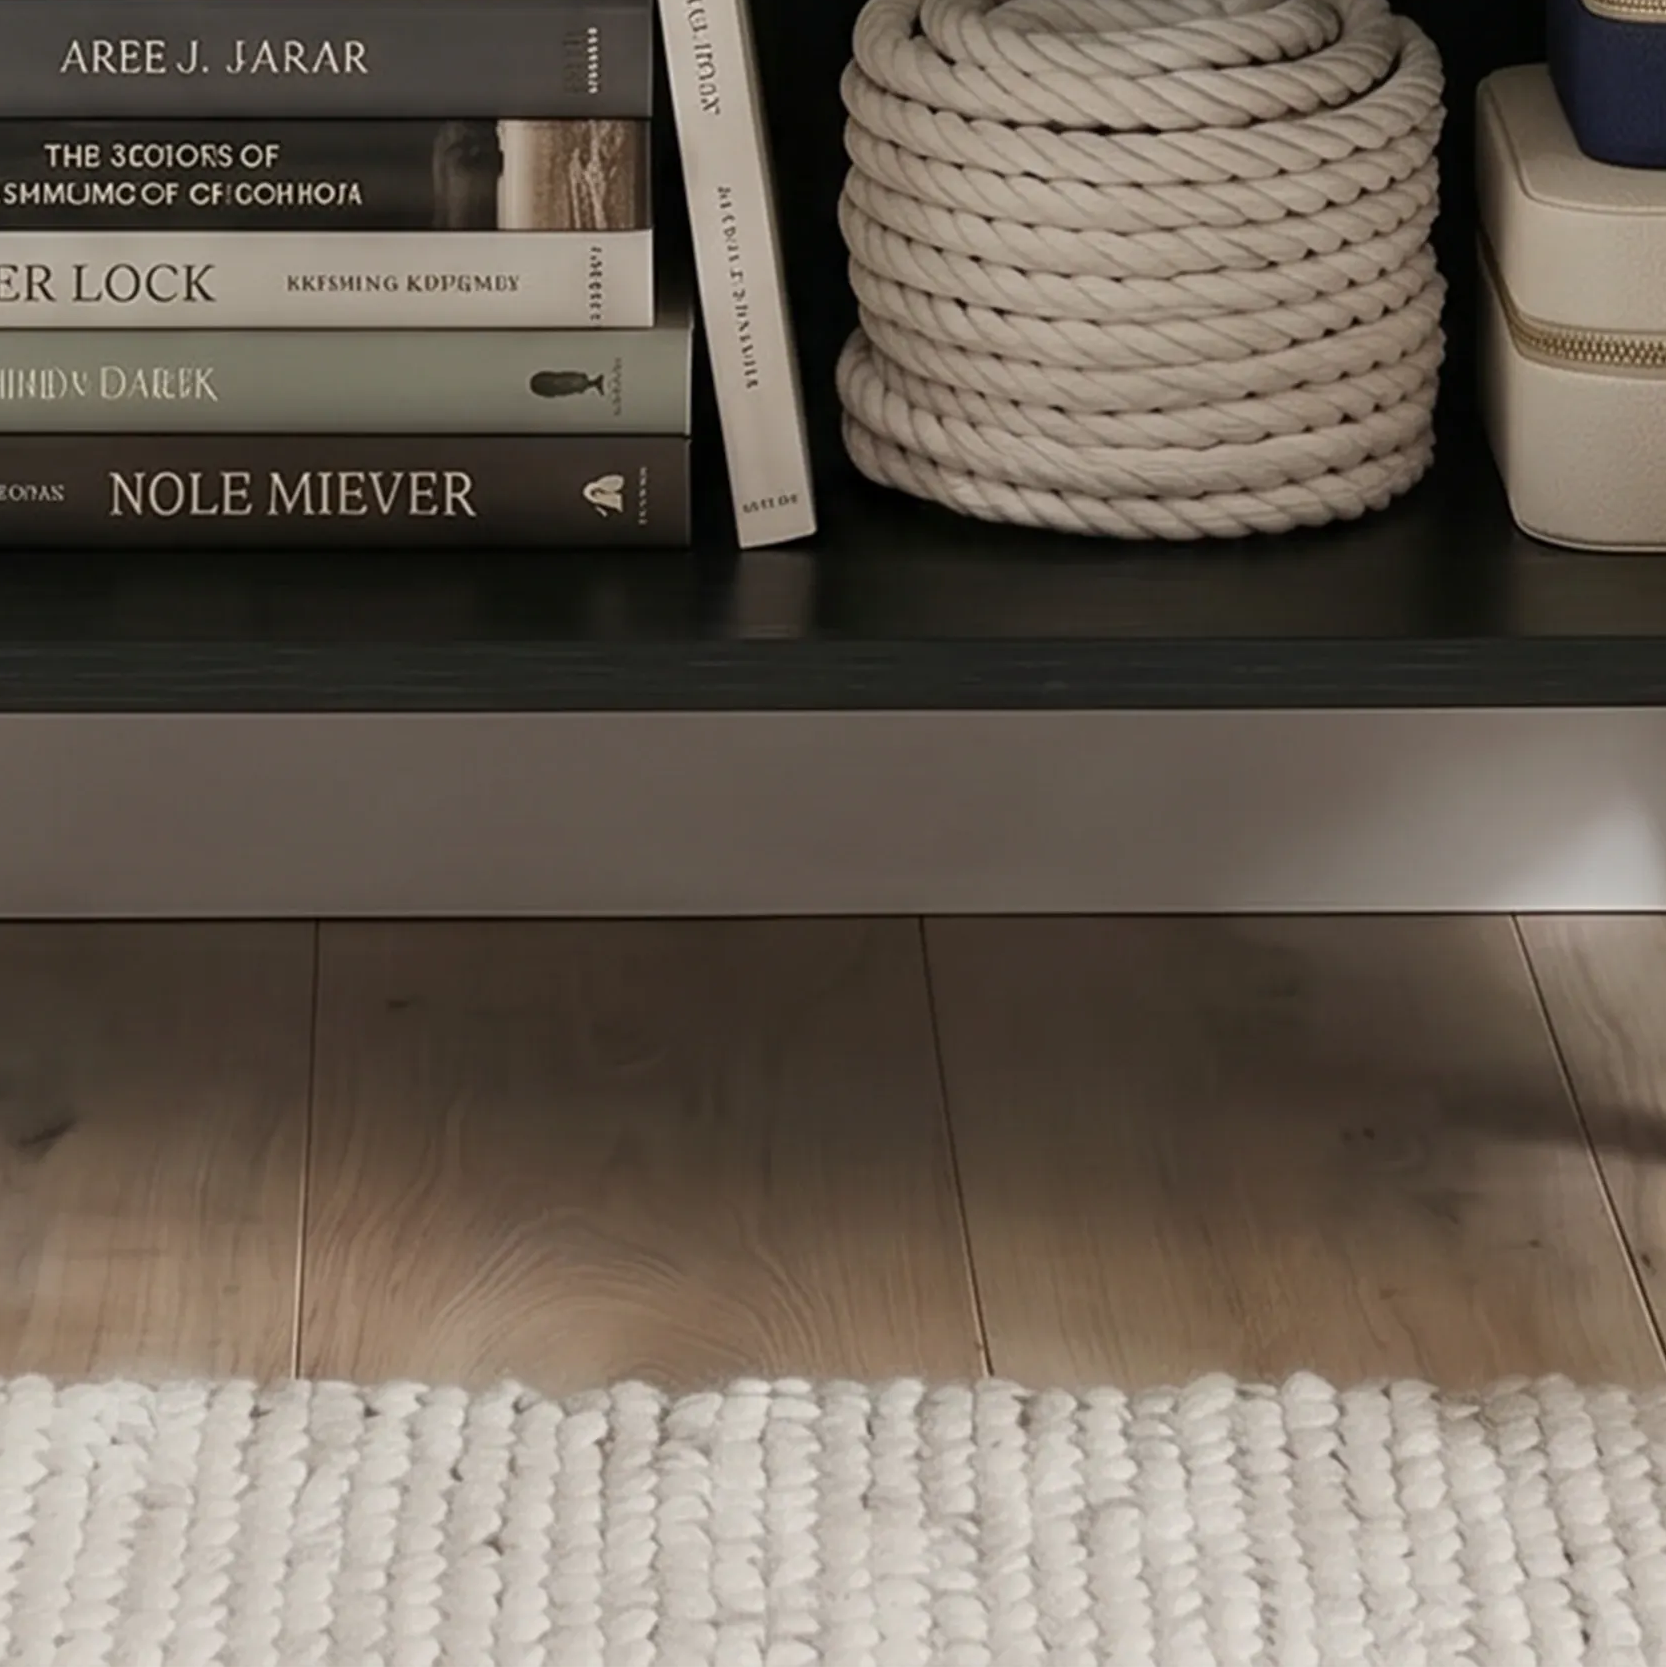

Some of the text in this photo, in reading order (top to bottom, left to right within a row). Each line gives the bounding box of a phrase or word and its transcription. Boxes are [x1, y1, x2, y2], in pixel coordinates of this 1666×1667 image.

[225, 39, 369, 74] JARAR
[239, 143, 281, 168] OF
[140, 181, 180, 206] OF
[72, 263, 217, 304] LOCK
[109, 471, 476, 517] NOLE MIEVER
